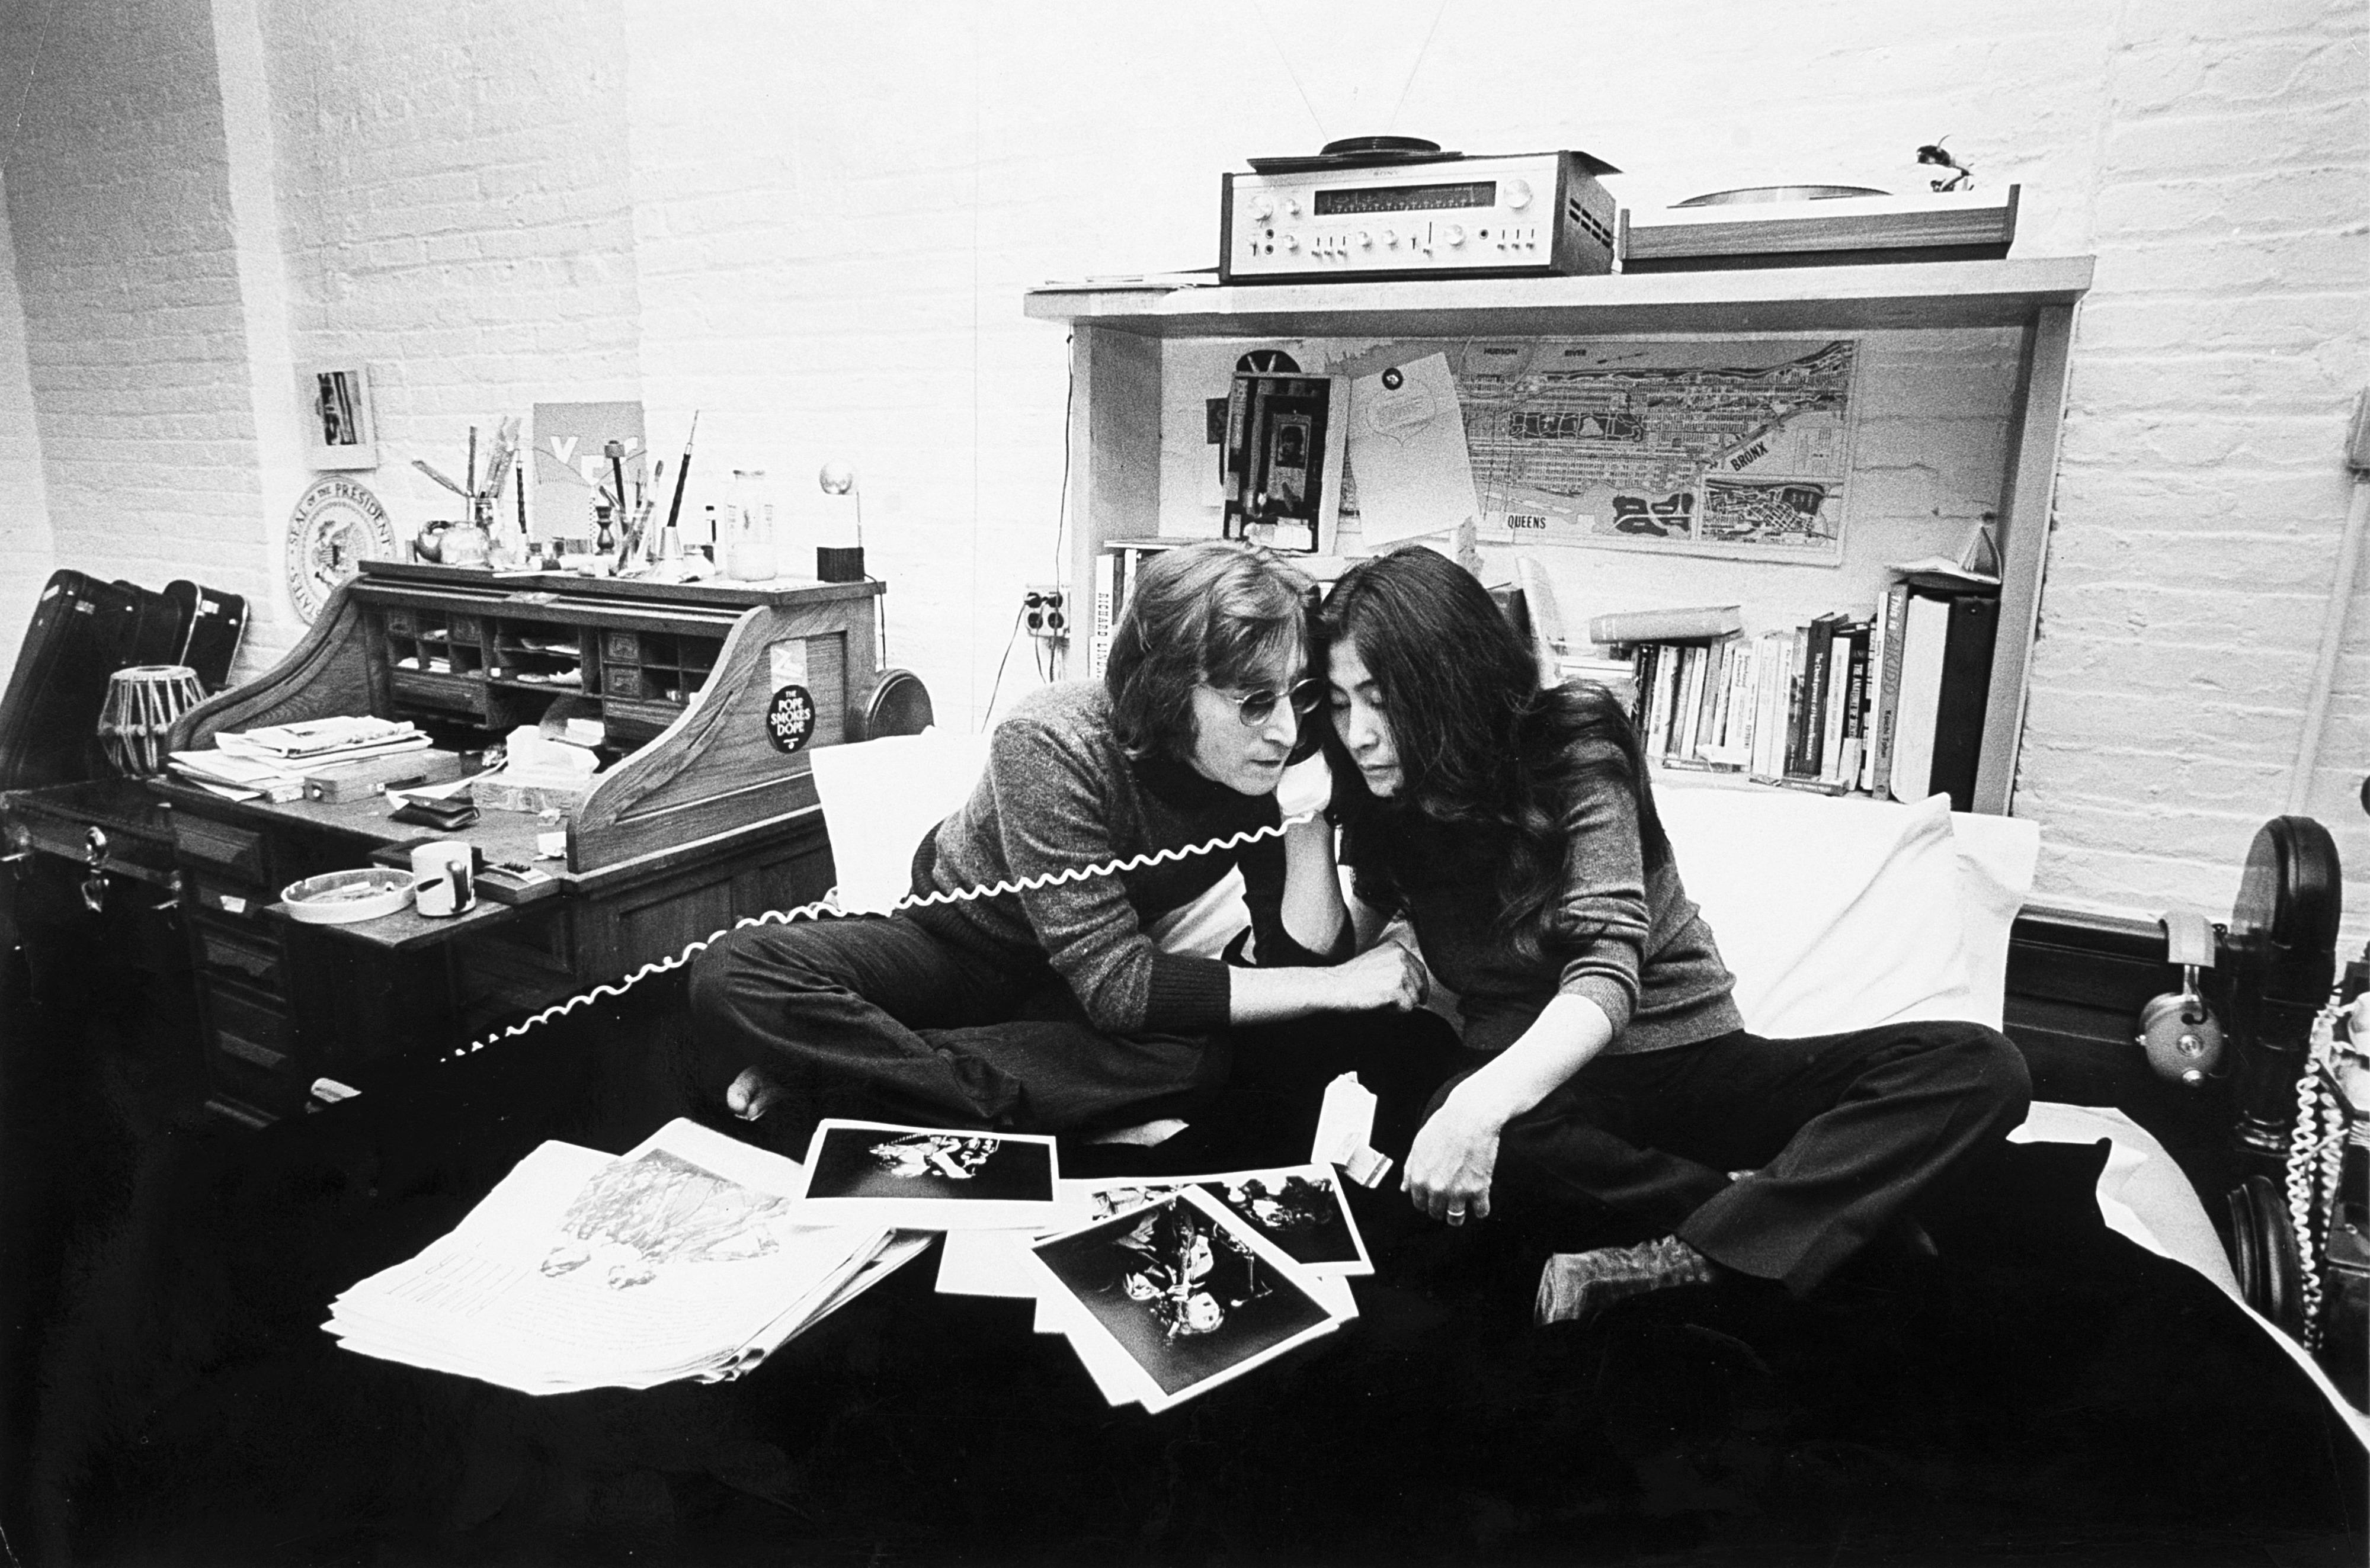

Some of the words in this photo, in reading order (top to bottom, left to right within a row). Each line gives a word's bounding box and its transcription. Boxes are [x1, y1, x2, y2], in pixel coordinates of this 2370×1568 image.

[1730, 441, 1769, 472] BRONX
[289, 508, 308, 546] SEAL
[307, 495, 316, 506] OF
[317, 486, 331, 498] THE
[335, 483, 392, 546] PRESIDENT
[1507, 515, 1546, 529] QUEENS
[1097, 592, 1109, 636] RICHARD
[1889, 595, 1902, 617] This
[1888, 620, 1900, 630] is
[1815, 653, 1823, 665] The
[1883, 634, 1901, 695] AIKIDO
[1853, 663, 1863, 676] THE
[778, 698, 803, 712] POPE
[770, 708, 811, 726] SMOKES
[777, 722, 805, 737] DOPE
